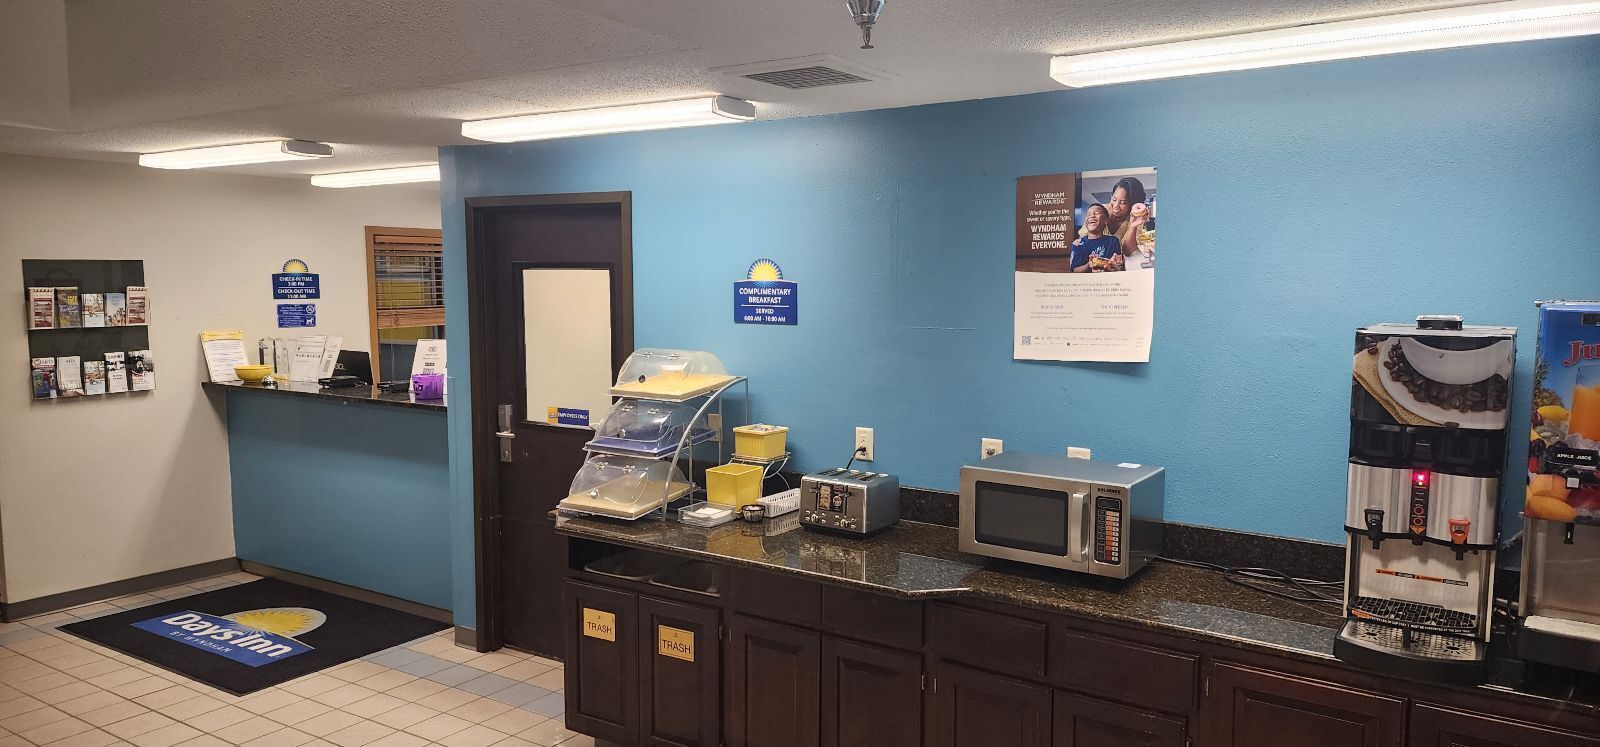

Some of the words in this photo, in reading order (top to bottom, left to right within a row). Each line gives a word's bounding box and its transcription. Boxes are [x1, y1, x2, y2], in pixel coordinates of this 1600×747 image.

[1030, 223, 1067, 233] WYNDHAM
[1032, 232, 1065, 241] REWARDS
[1031, 240, 1068, 250] EVERYONE.
[738, 287, 792, 296] COMPLIMENTARY
[748, 296, 782, 304] BREAKFAST
[755, 307, 774, 315] SERVED
[587, 621, 612, 634] TRASH
[161, 613, 243, 641] Days
[228, 633, 293, 658] Inn
[184, 635, 233, 653] WYNDHAM
[662, 639, 691, 655] TRASH
